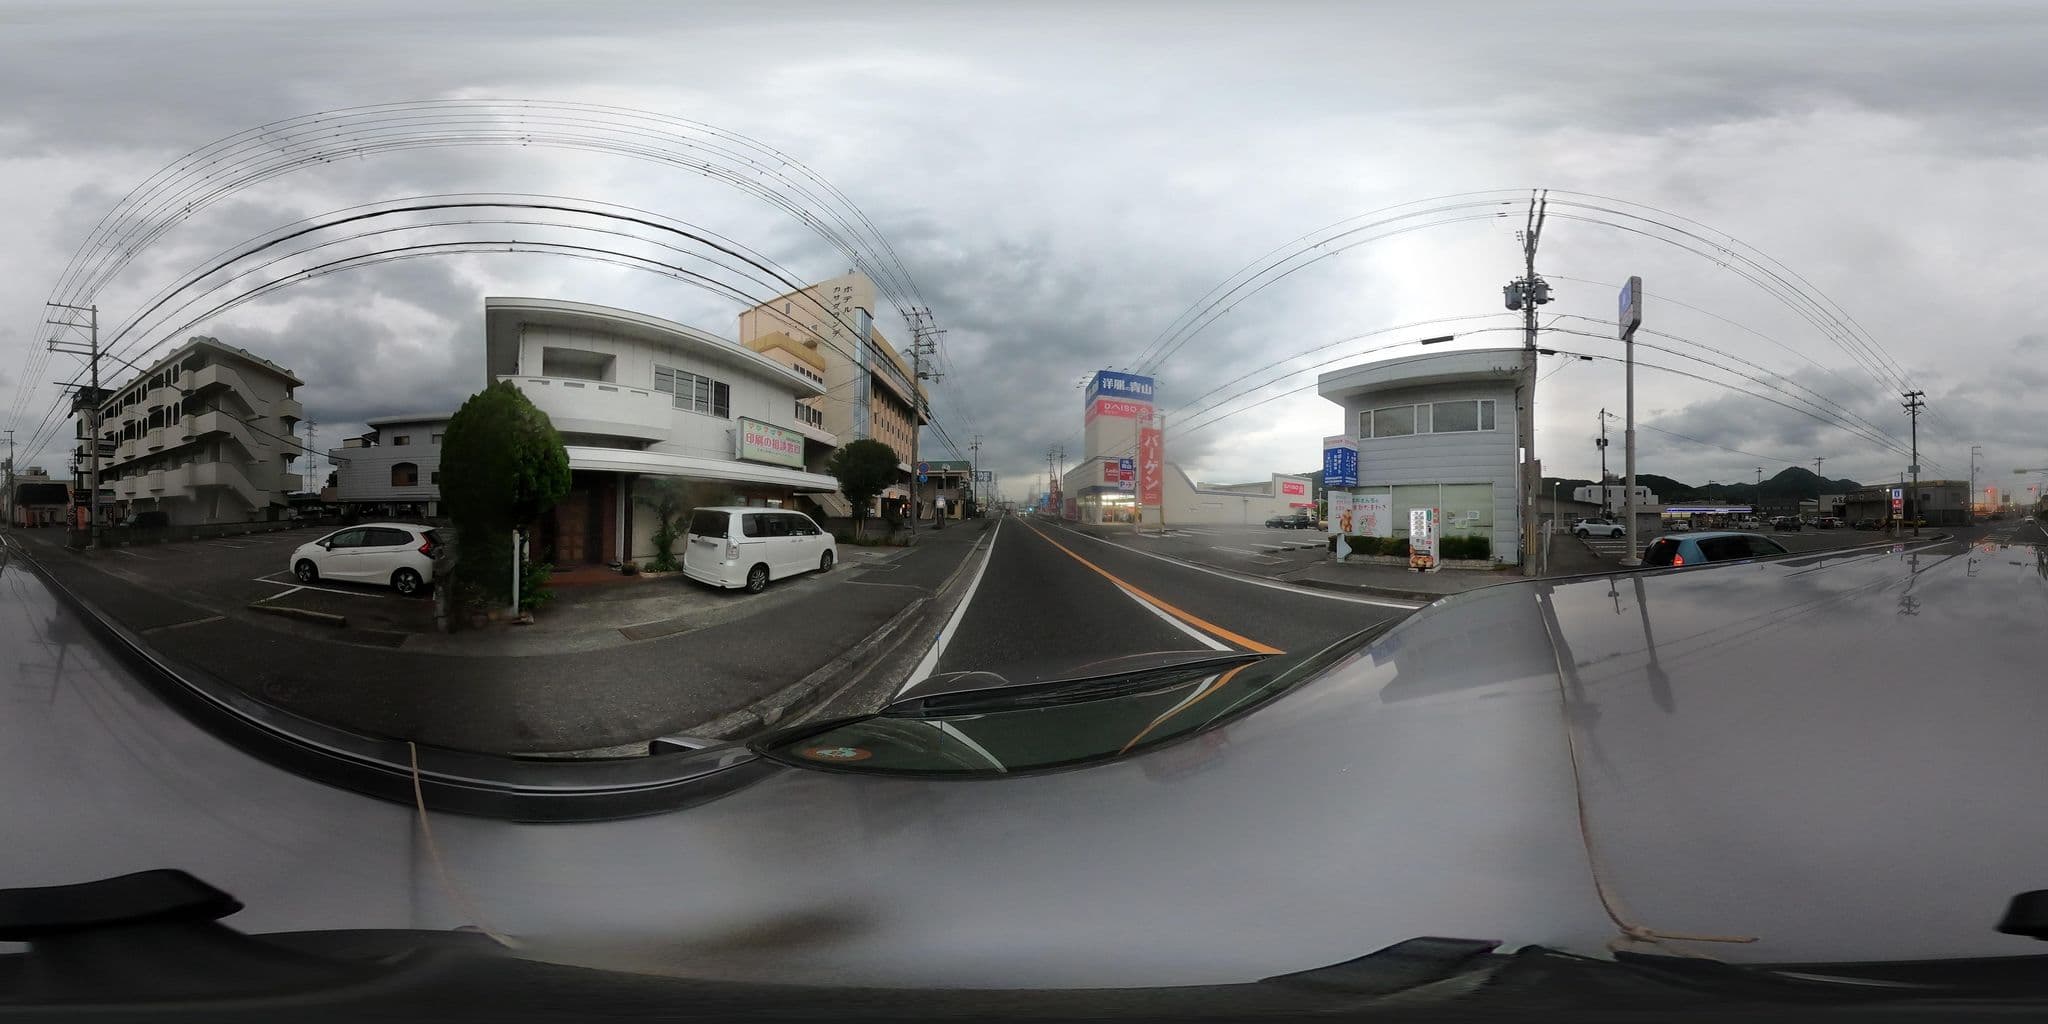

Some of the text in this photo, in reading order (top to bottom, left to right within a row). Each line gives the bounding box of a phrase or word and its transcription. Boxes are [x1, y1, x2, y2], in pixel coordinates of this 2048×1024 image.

[843, 286, 853, 313] ホテル
[1103, 377, 1152, 395] 洋服の青山
[1104, 402, 1137, 413] DAISO
[745, 432, 801, 455] 印刷の相談窓口
[1144, 434, 1160, 491] バーゲン
